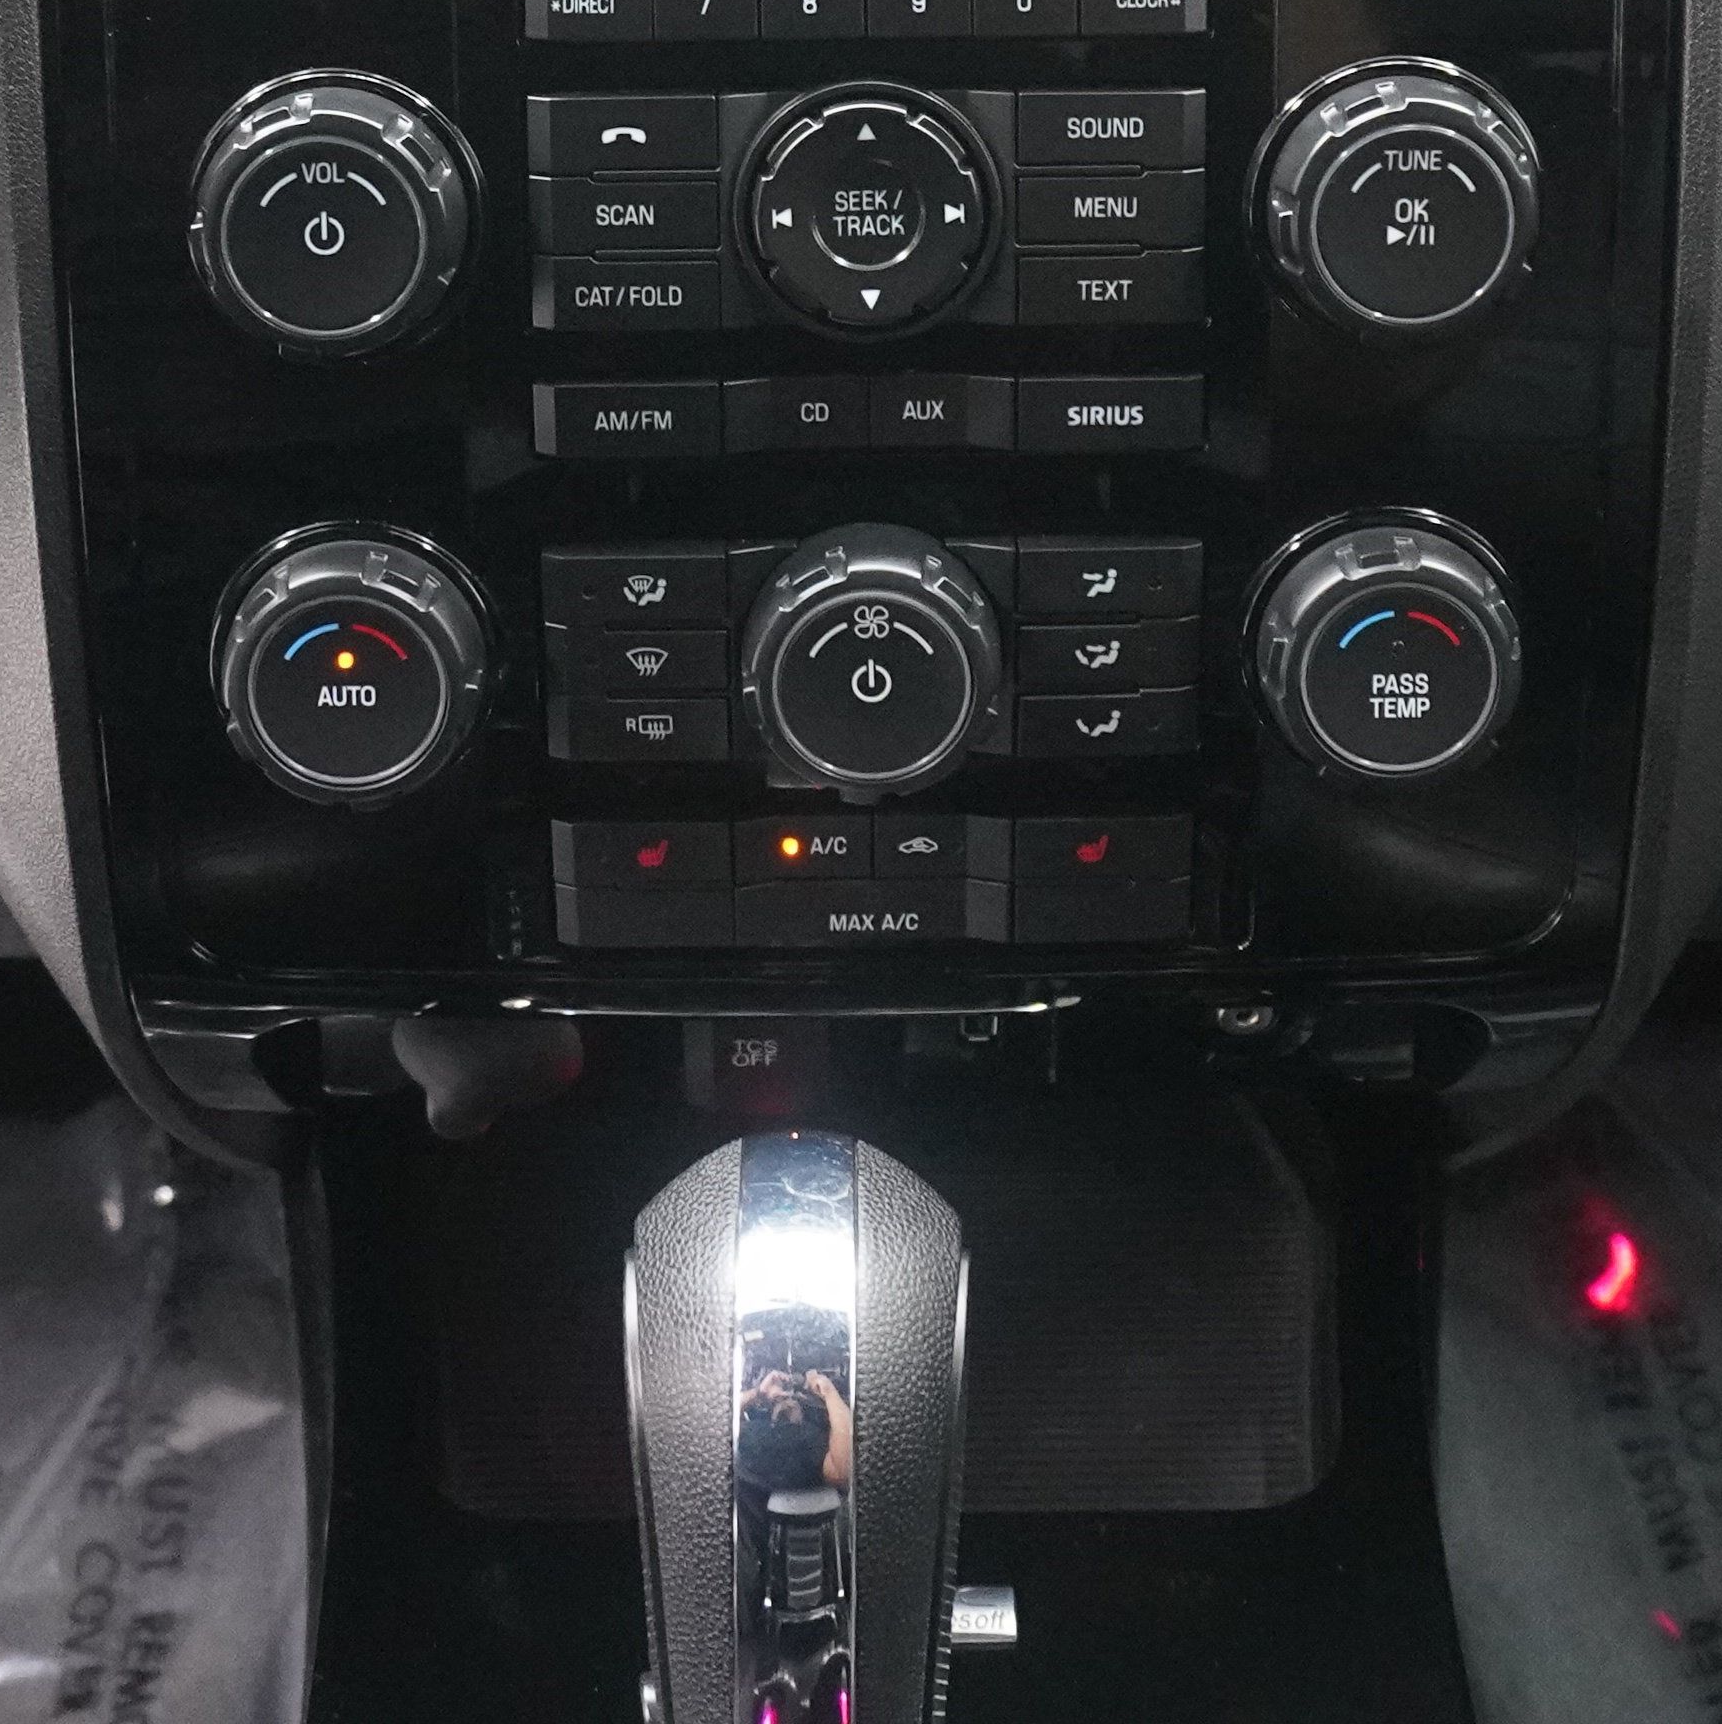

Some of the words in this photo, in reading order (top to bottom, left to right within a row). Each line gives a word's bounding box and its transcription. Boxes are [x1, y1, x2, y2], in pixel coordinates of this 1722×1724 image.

[1067, 116, 1145, 141] SOUND
[1384, 149, 1444, 173] TUNE
[301, 161, 346, 186] VOL
[596, 204, 656, 228] SCAN
[1074, 196, 1140, 220] MENU
[1395, 197, 1430, 224] OK
[833, 215, 907, 239] TRACK
[1077, 279, 1134, 303] TEXT
[594, 410, 674, 433] AM/FM
[800, 402, 832, 425] CD
[902, 400, 945, 422] AUX
[1067, 405, 1145, 428] SIRIUS
[1372, 673, 1430, 696] PASS
[317, 685, 378, 709] AUTO
[1369, 697, 1432, 721] TEMP
[625, 717, 637, 734] R
[810, 836, 849, 857] A/C
[829, 913, 875, 933] MAX
[881, 912, 920, 933] A/C
[732, 1038, 778, 1054] TCS
[731, 1052, 778, 1069] OFF
